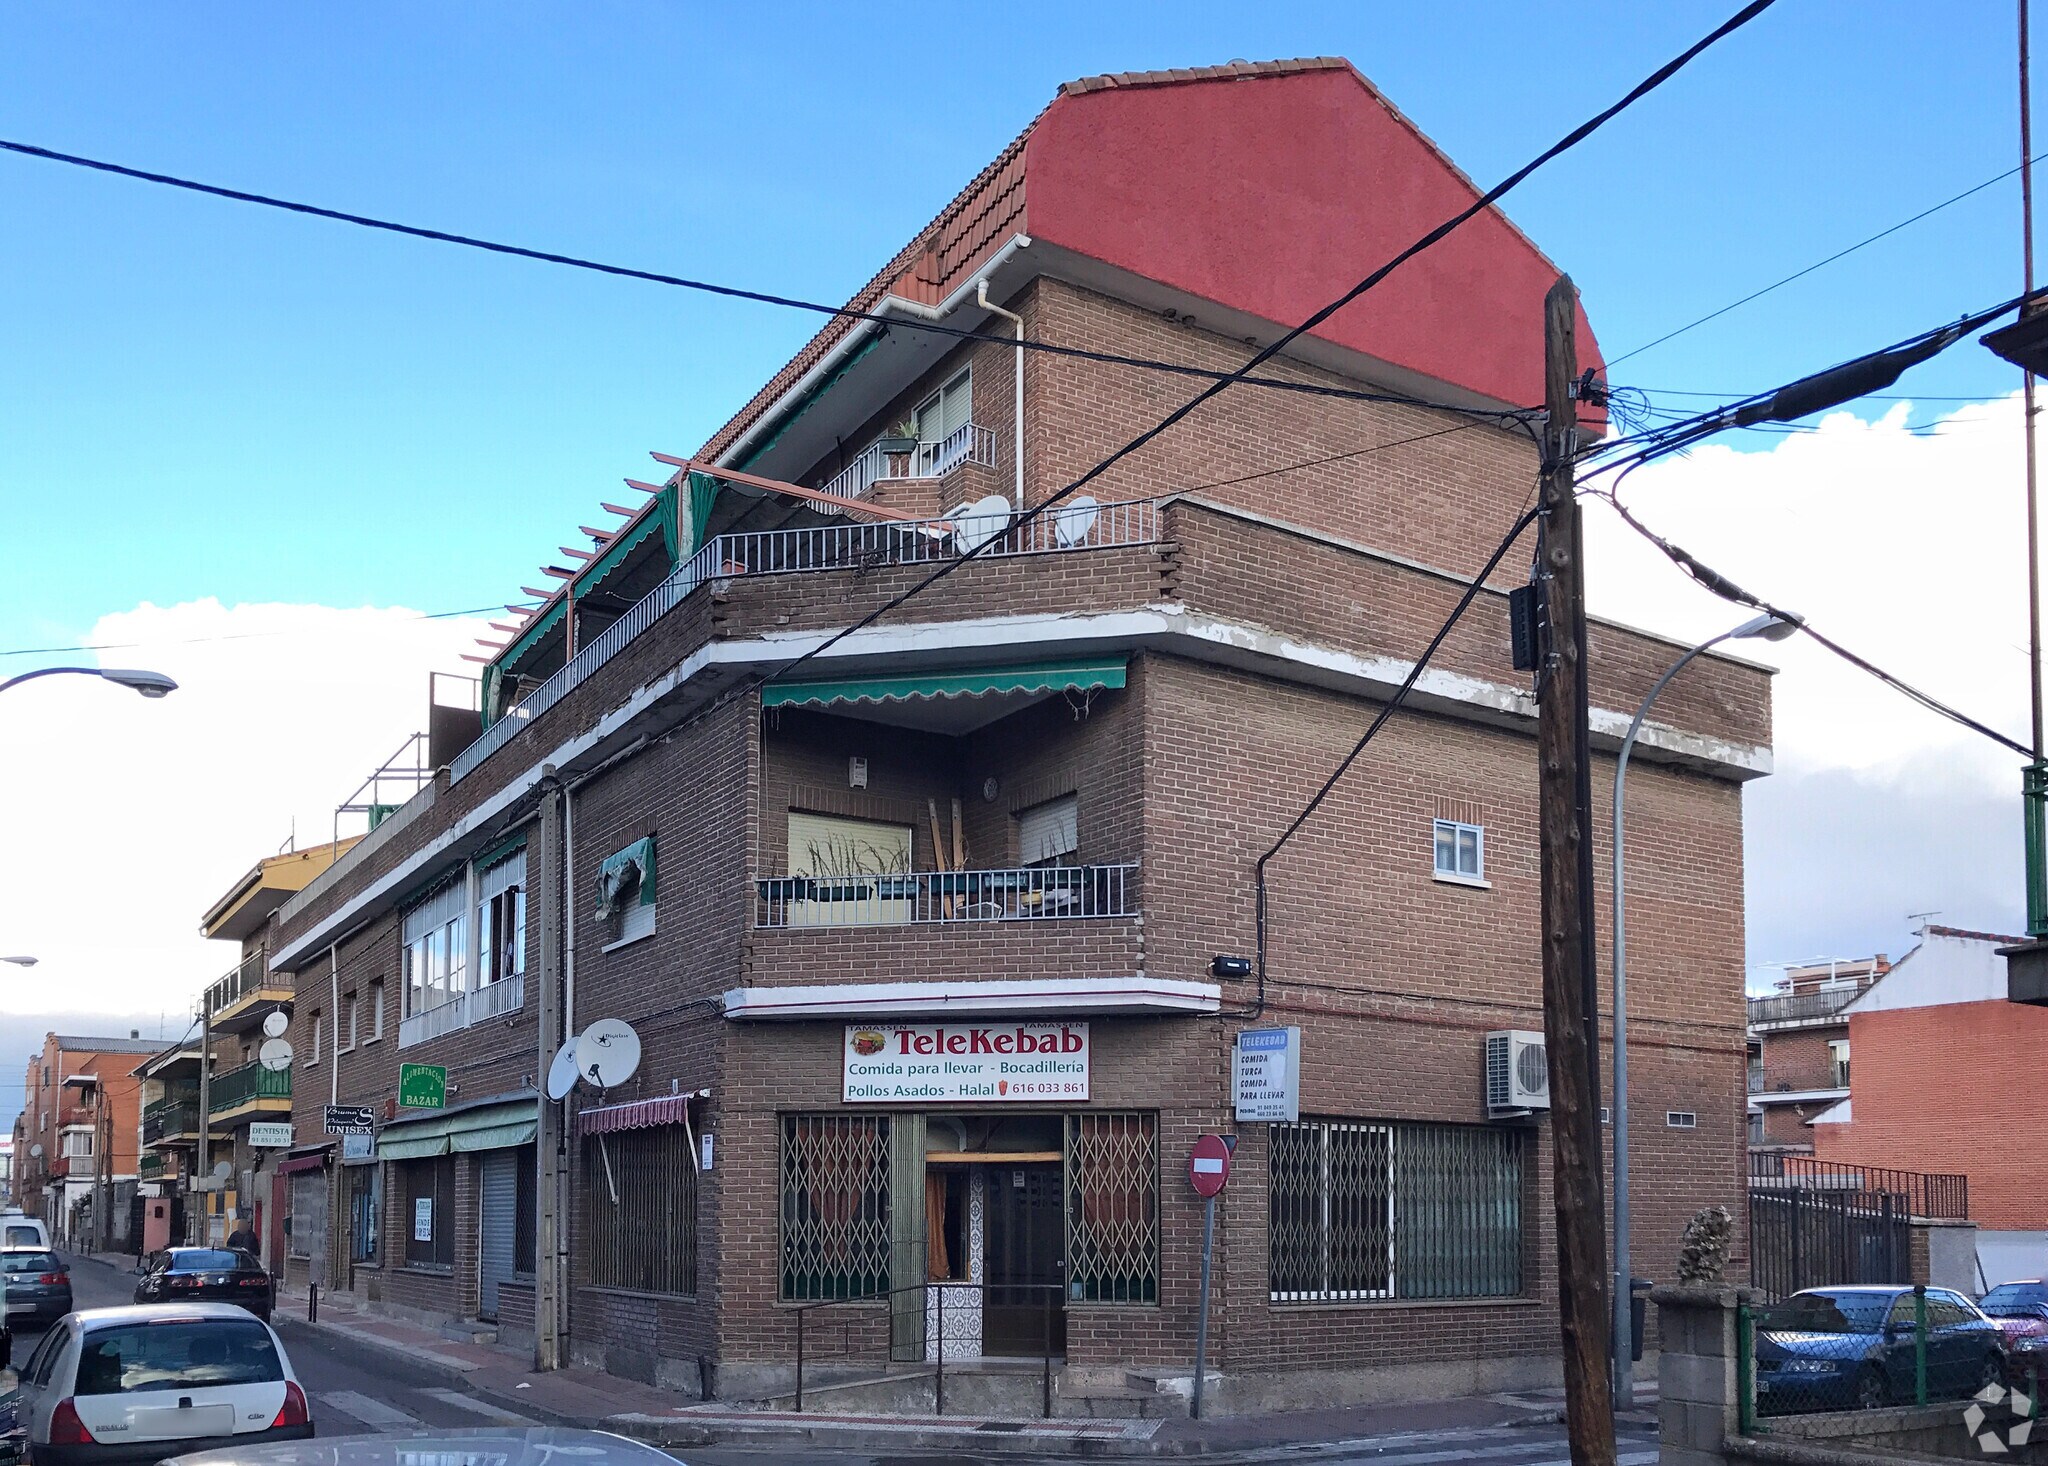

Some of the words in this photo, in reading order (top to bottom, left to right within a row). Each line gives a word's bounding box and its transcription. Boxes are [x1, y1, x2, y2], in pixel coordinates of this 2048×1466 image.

[893, 1027, 1083, 1055] TeleKebab
[1241, 1035, 1286, 1047] TELEKEBAB
[1241, 1054, 1268, 1063] COMIDA
[849, 1062, 903, 1075] Comida
[908, 1065, 939, 1077] para
[944, 1061, 983, 1074] llevar
[1000, 1060, 1084, 1073] Bocadillería
[1241, 1067, 1262, 1076] TURCA
[1240, 1079, 1267, 1088] COMIDA
[848, 1085, 889, 1096] Pollos
[894, 1084, 945, 1096] Asados
[959, 1083, 994, 1095] Halal
[1012, 1083, 1034, 1093] 616
[1038, 1083, 1060, 1093] 033
[1064, 1082, 1084, 1093] 861
[406, 1094, 439, 1106] BAZAR
[1240, 1091, 1257, 1100] PARA
[1259, 1091, 1285, 1099] LLEVAR
[252, 1127, 290, 1135] DENTISTA
[327, 1126, 373, 1135] UNISEX
